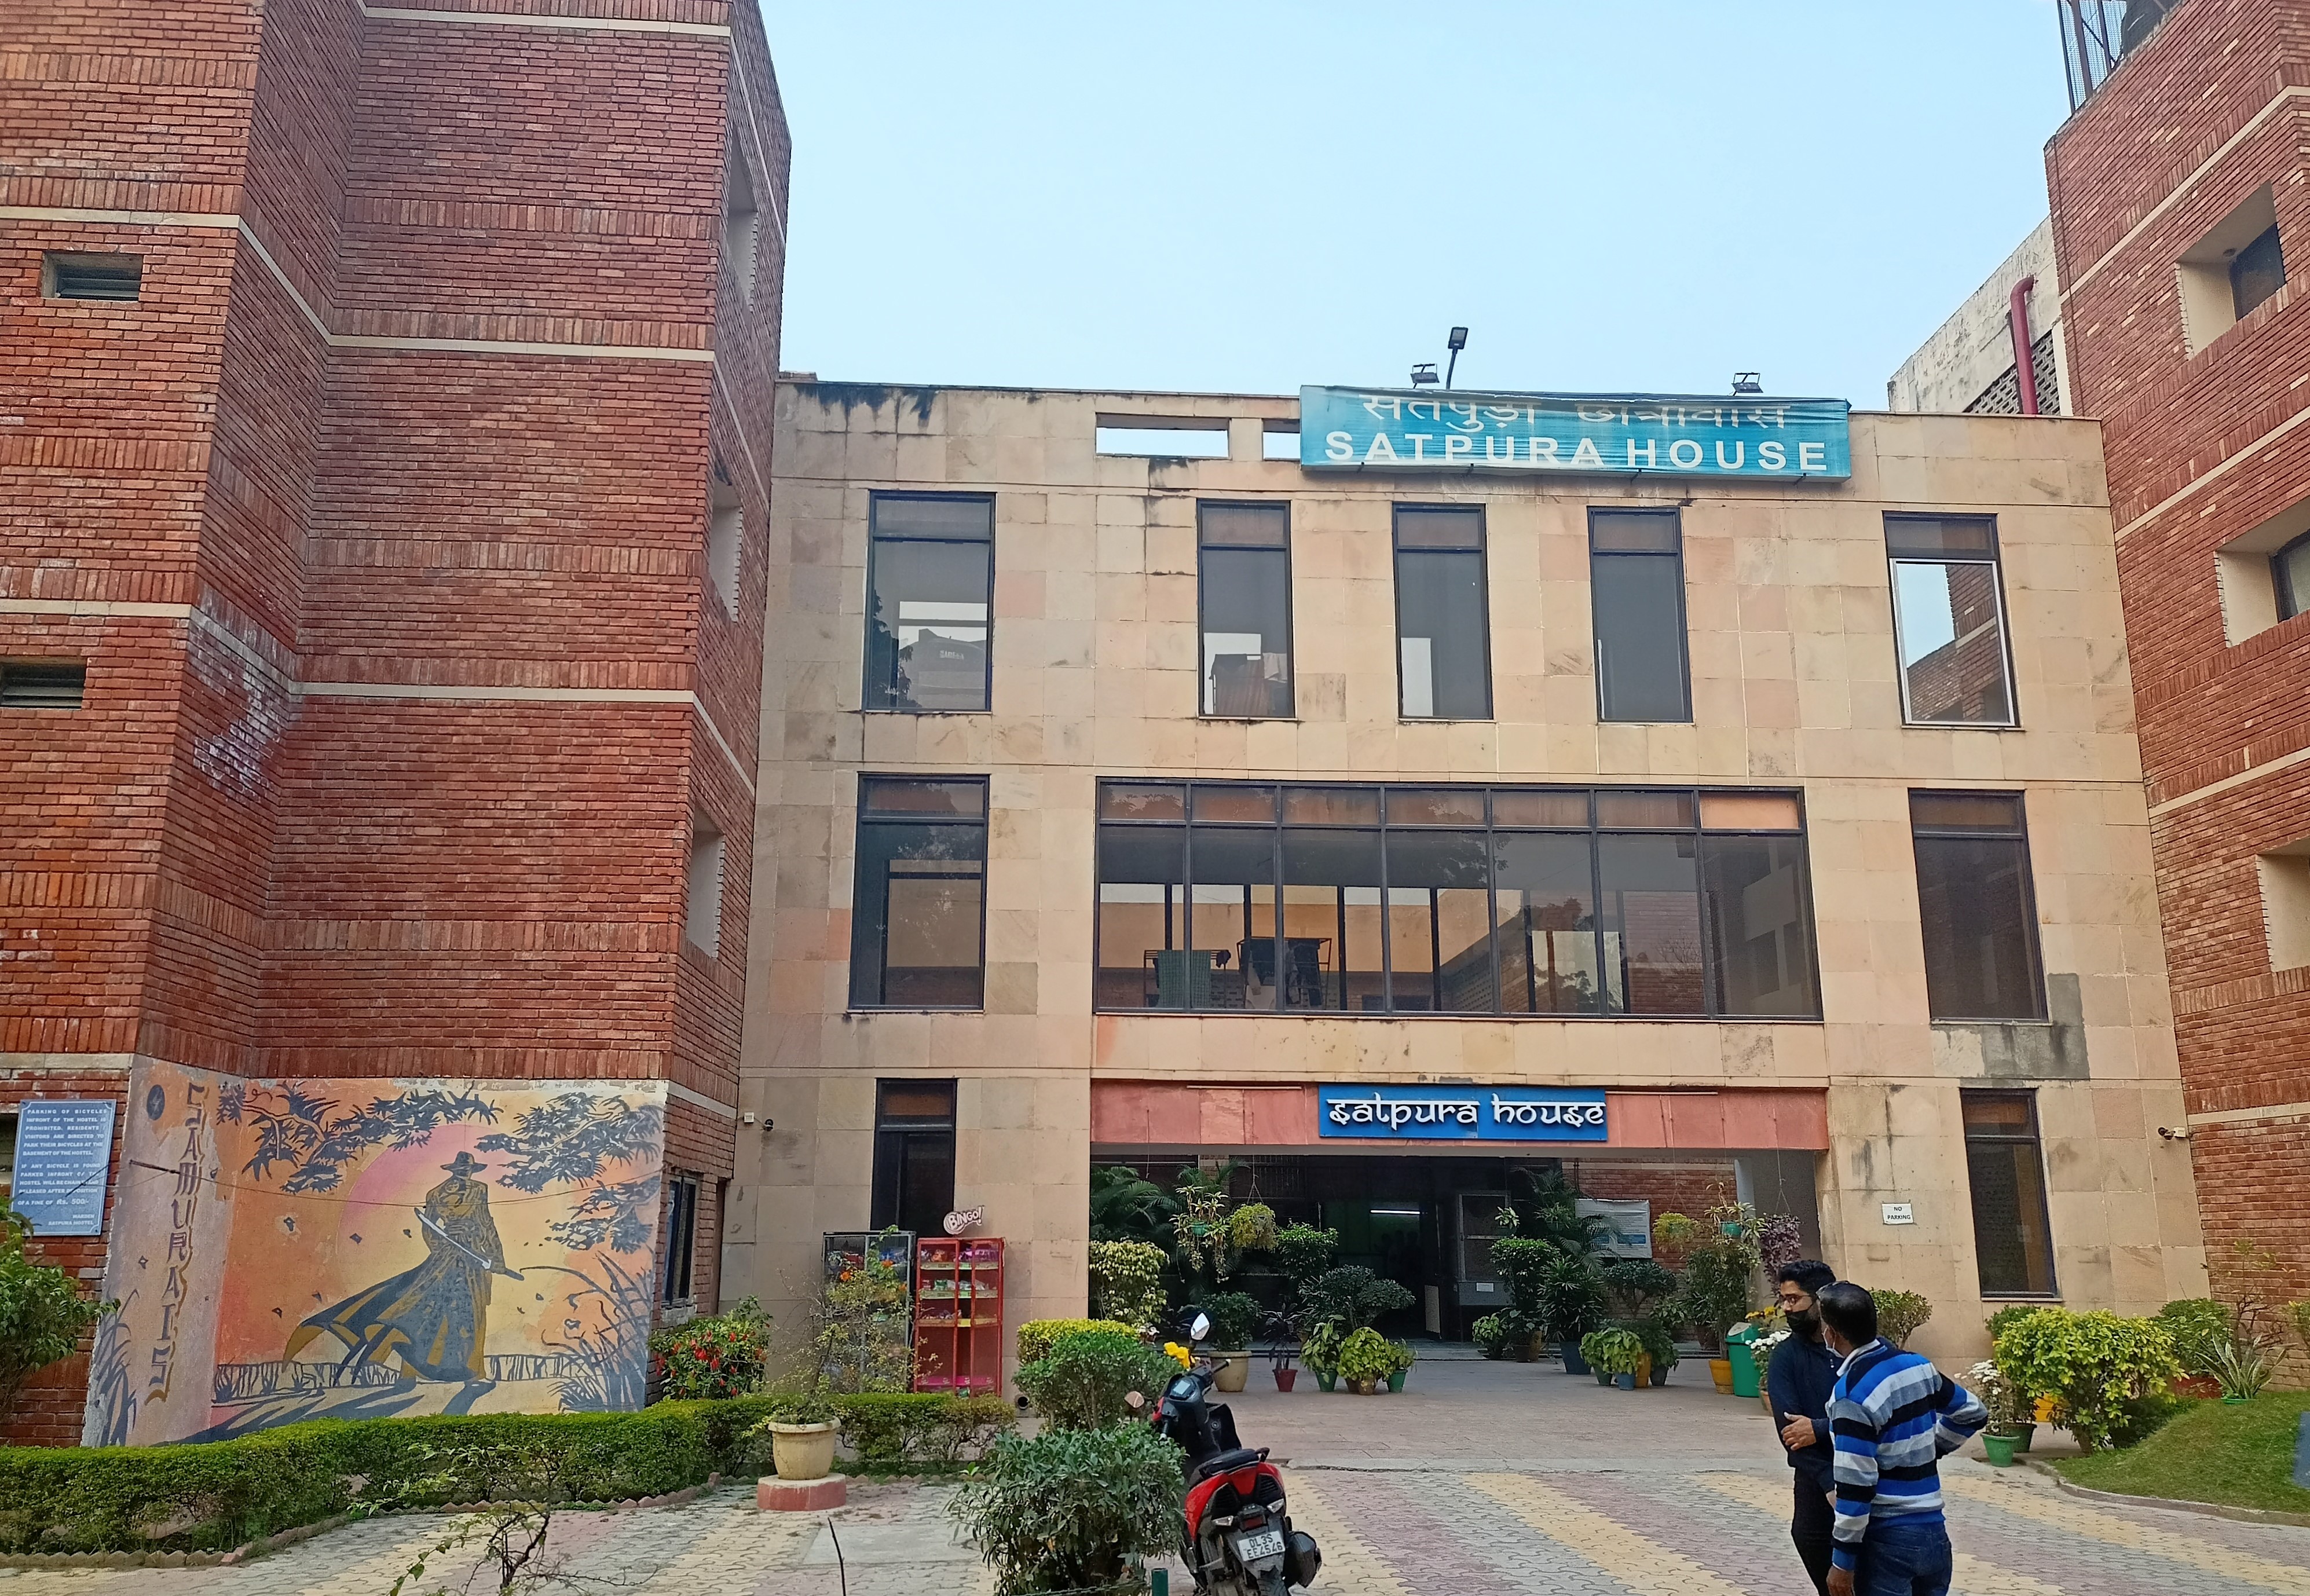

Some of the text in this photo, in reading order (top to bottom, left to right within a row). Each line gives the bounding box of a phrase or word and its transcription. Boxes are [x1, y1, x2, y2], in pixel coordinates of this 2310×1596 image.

[1359, 394, 1542, 433] सतपुड़ा
[1324, 431, 1828, 471] SATPURA HOUSE
[1326, 1092, 1606, 1130] satpura house
[148, 1082, 208, 1388] SAMURAIS
[948, 1206, 983, 1230] BINGO!
[1247, 1542, 1283, 1559] EE4546
[1249, 1533, 1273, 1548] DL3S
